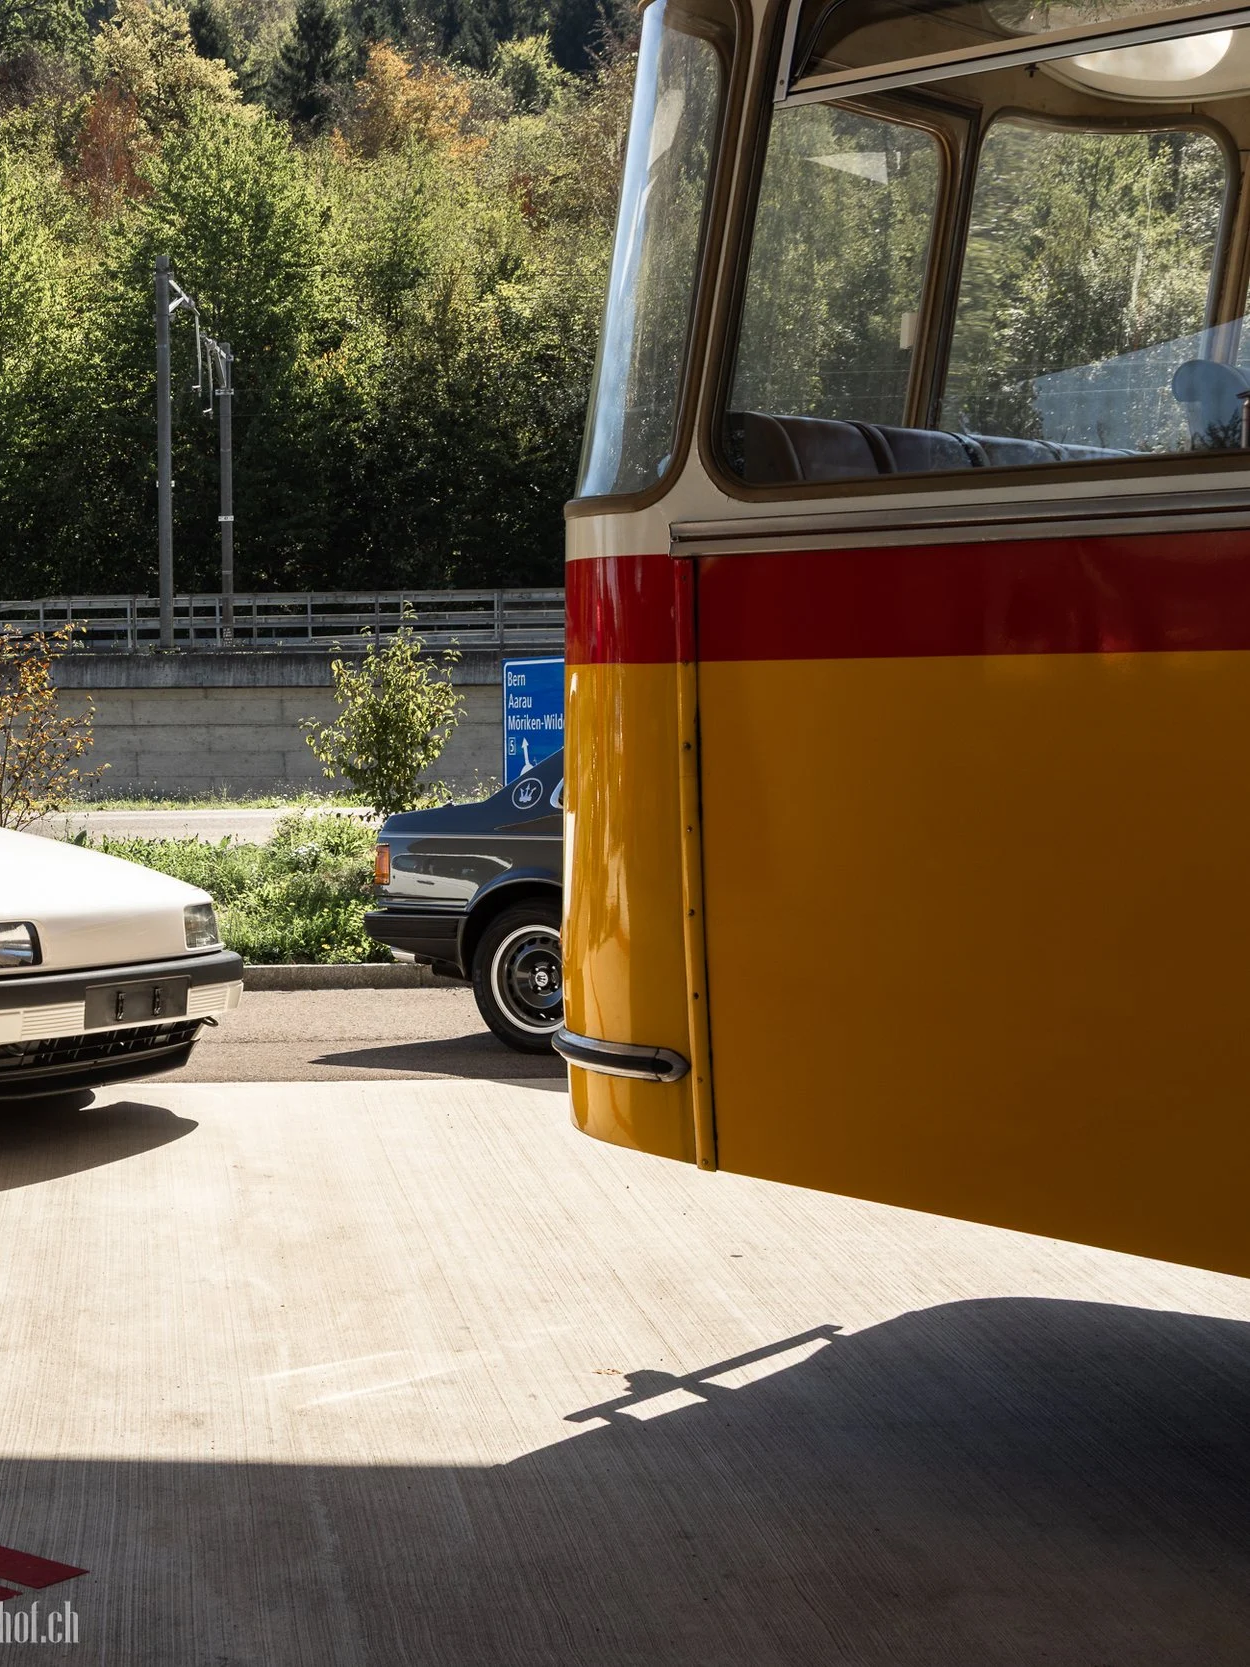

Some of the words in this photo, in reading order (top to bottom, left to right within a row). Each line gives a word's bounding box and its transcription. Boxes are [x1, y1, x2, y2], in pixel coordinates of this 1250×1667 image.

[507, 671, 526, 687] Bern
[508, 693, 533, 709] Aarau
[508, 713, 564, 730] Möriken-Wild
